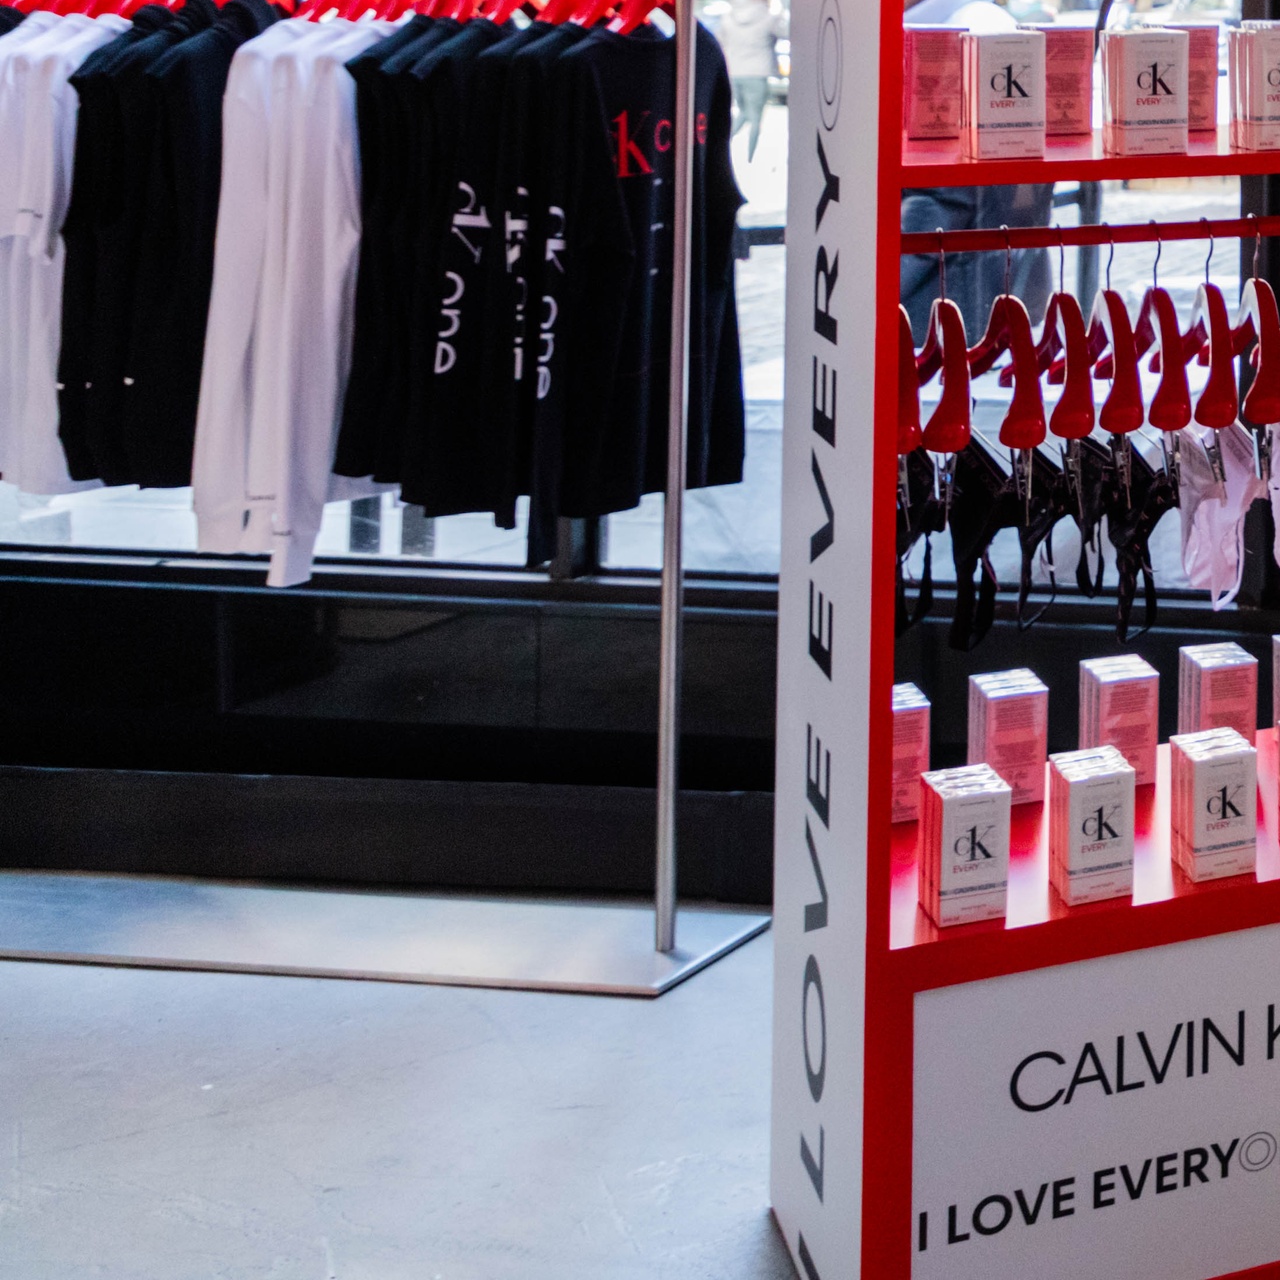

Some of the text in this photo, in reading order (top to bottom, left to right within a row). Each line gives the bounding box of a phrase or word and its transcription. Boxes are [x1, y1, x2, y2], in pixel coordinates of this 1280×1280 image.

[800, 722, 832, 1206] LOVE
[1009, 1009, 1246, 1113] CALVIN
[917, 1211, 929, 1253] I
[946, 1175, 1077, 1246] LOVE
